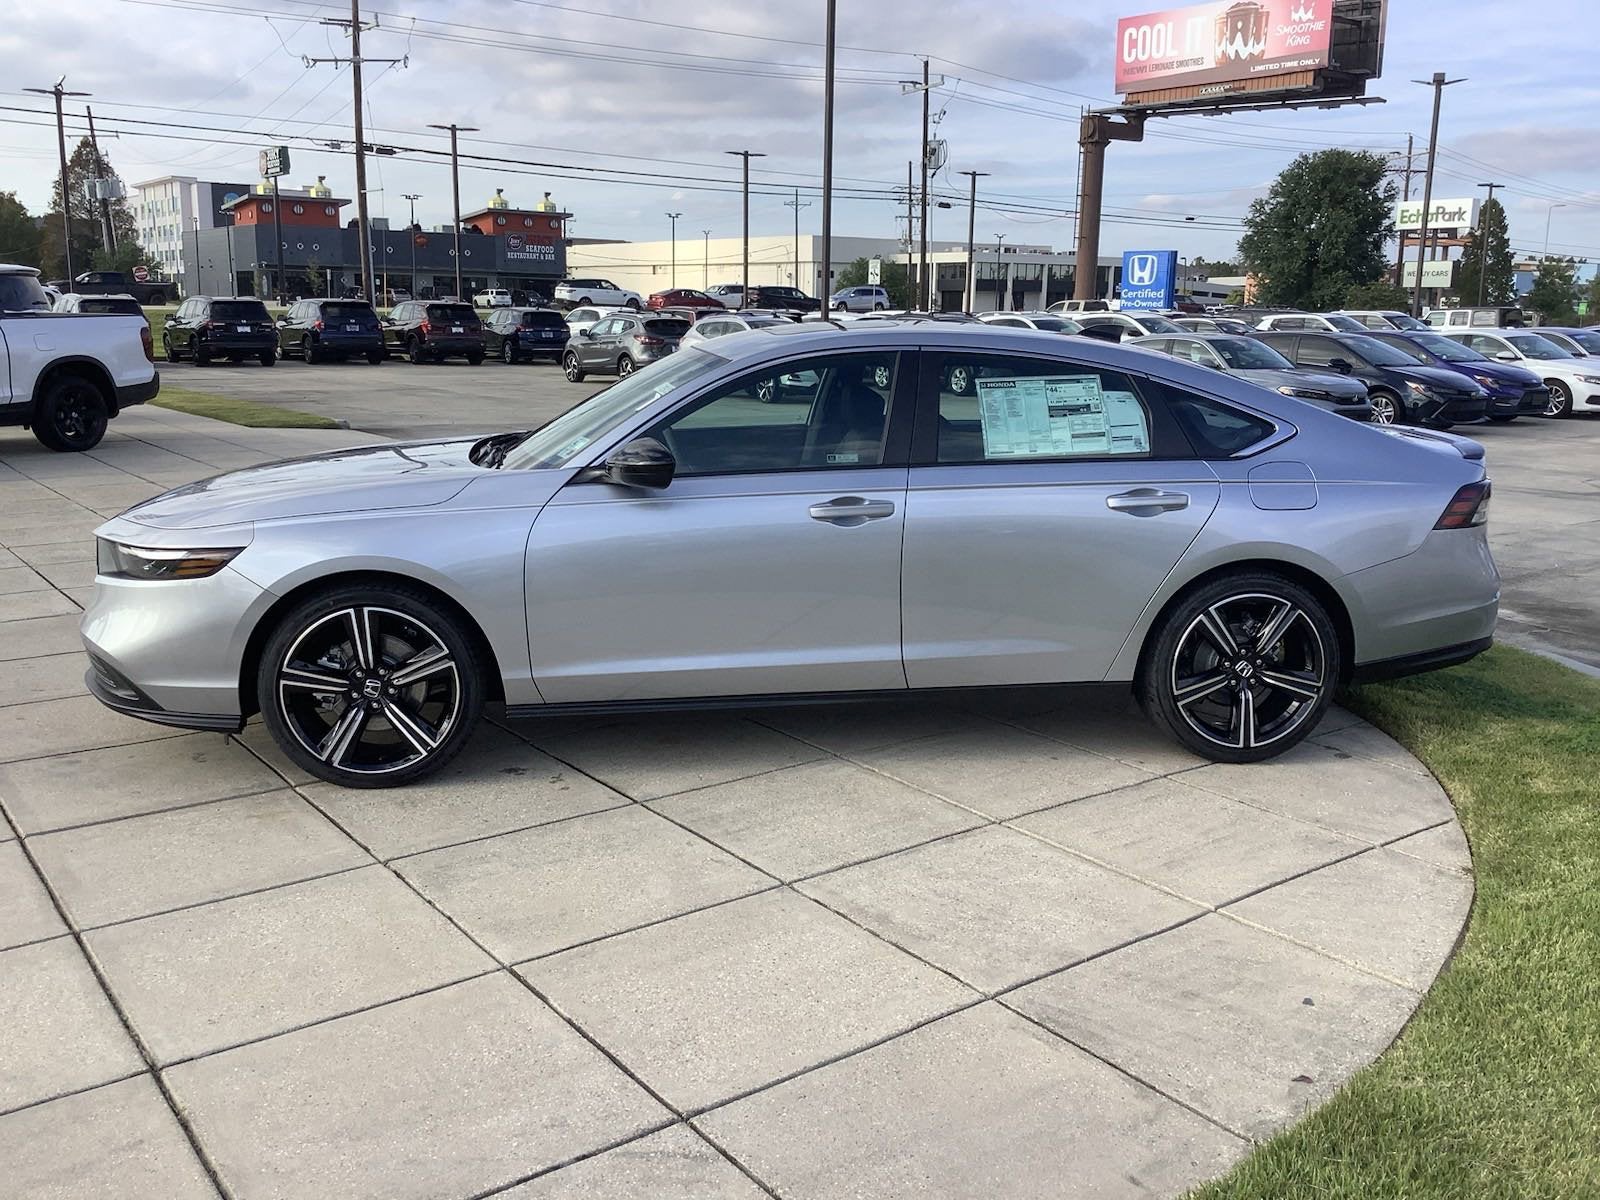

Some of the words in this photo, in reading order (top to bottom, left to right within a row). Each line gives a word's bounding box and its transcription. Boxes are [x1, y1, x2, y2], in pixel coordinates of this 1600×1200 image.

[1275, 20, 1326, 36] SMOOTHIE
[1123, 22, 1178, 64] COOL
[1185, 16, 1207, 54] IT
[1148, 61, 1175, 73] LEMONADE
[1175, 57, 1205, 69] SMOOTHIES
[1250, 62, 1280, 73] LIMITED
[1280, 60, 1299, 69] TIME
[1299, 57, 1320, 67] ONLY
[526, 245, 554, 253] SEAFOOD
[1121, 289, 1164, 298] Certified
